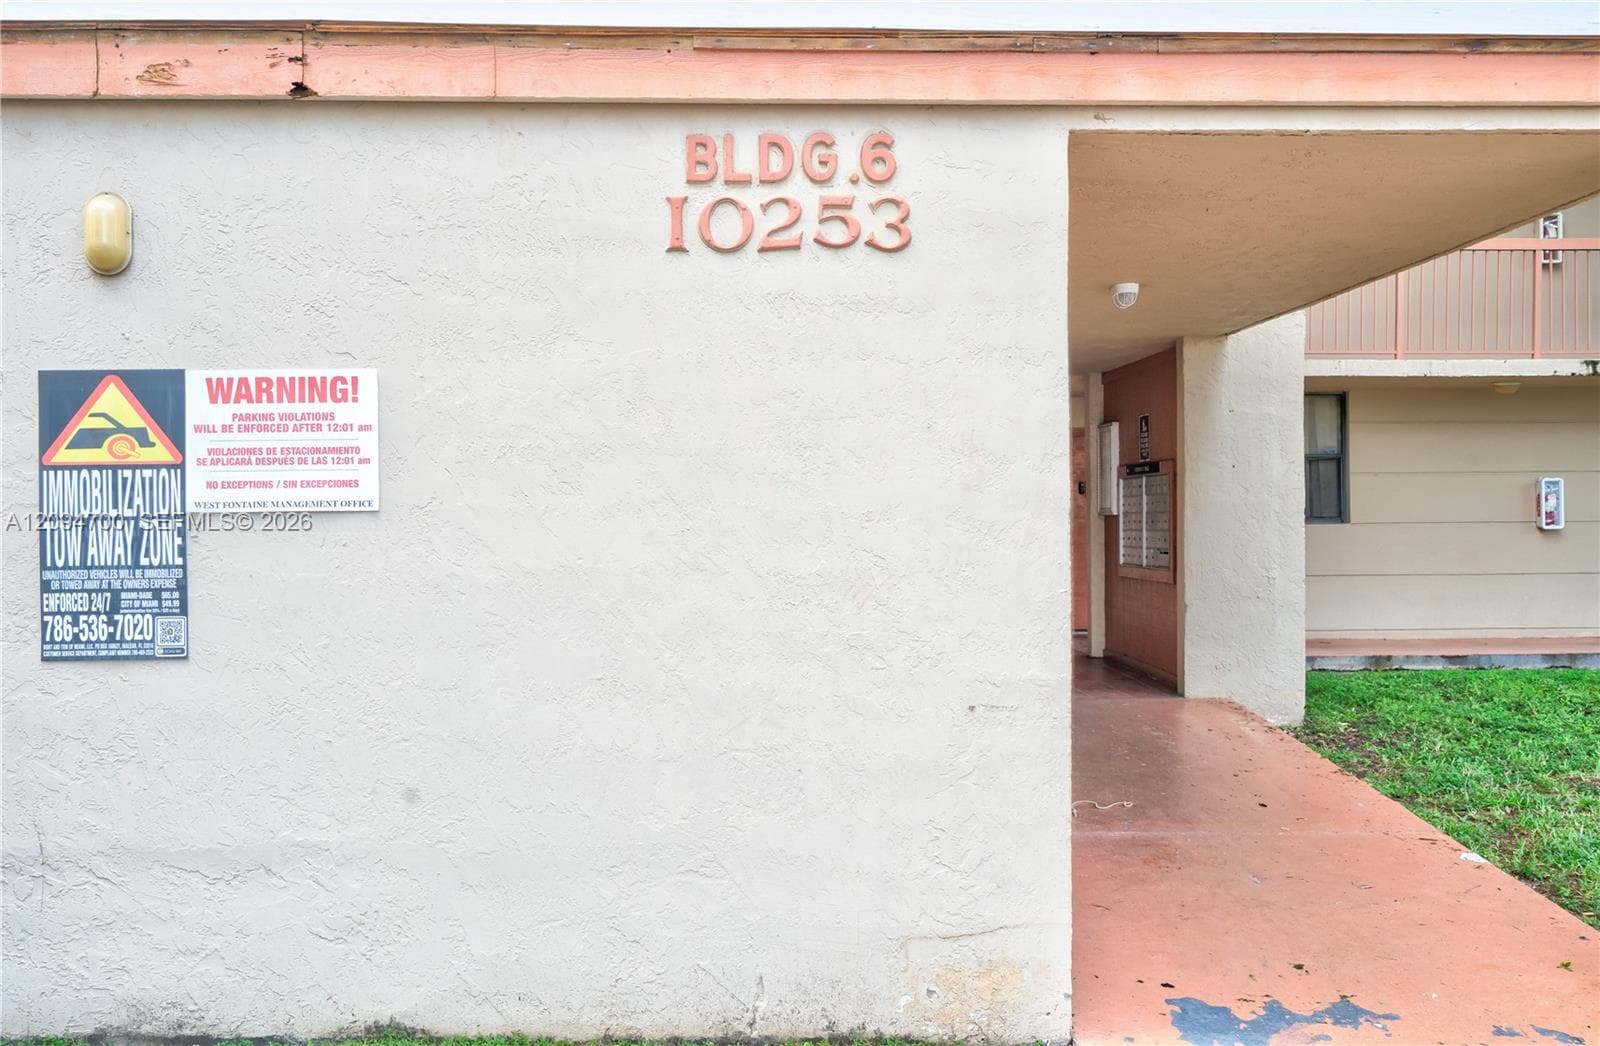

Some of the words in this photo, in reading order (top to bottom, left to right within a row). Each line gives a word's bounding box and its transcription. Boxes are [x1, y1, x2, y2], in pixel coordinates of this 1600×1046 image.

[665, 195, 913, 252] 10253
[206, 376, 359, 404] WARNING!
[232, 413, 275, 422] PARKING
[279, 412, 335, 421] VIOLATIONS
[194, 424, 218, 433] WILL
[221, 424, 234, 433] BE
[237, 424, 289, 432] ENFORCED
[292, 424, 322, 432] AFTER
[327, 423, 353, 432] 12:01
[207, 447, 263, 456] VIOLACIONES
[266, 447, 278, 455] DE
[280, 446, 360, 455] ESTACIONAMIENTO
[196, 458, 207, 466] SE
[210, 456, 252, 466] APLICARÁ
[255, 455, 294, 465] DESPUÉS
[206, 481, 218, 489] NO
[221, 480, 274, 489] EXCEPTIONS
[283, 480, 298, 488] SIN
[300, 480, 359, 488] EXCEPCIONES
[42, 468, 182, 517] IMMOBILIZATION
[223, 501, 268, 509] FONTAINE
[270, 500, 338, 508] MANAGEMENT
[44, 519, 82, 567] TOW
[87, 519, 134, 566] AWAY
[140, 518, 183, 566] ZONE
[42, 570, 88, 580] UNAUTHORIZED
[89, 570, 118, 579] VEHICLES
[119, 570, 134, 579] WILL
[135, 569, 143, 578] BE
[144, 569, 183, 578] IMMOBILIZED
[51, 580, 60, 589] OR
[61, 580, 82, 589] TOWED
[101, 580, 109, 589] AT
[110, 580, 122, 589] THE
[123, 579, 150, 589] OWNERS
[150, 579, 177, 588] EXPENSE
[43, 593, 89, 612] ENFORCED
[91, 592, 111, 612] 24/7
[44, 614, 152, 642] 786-536-7020
